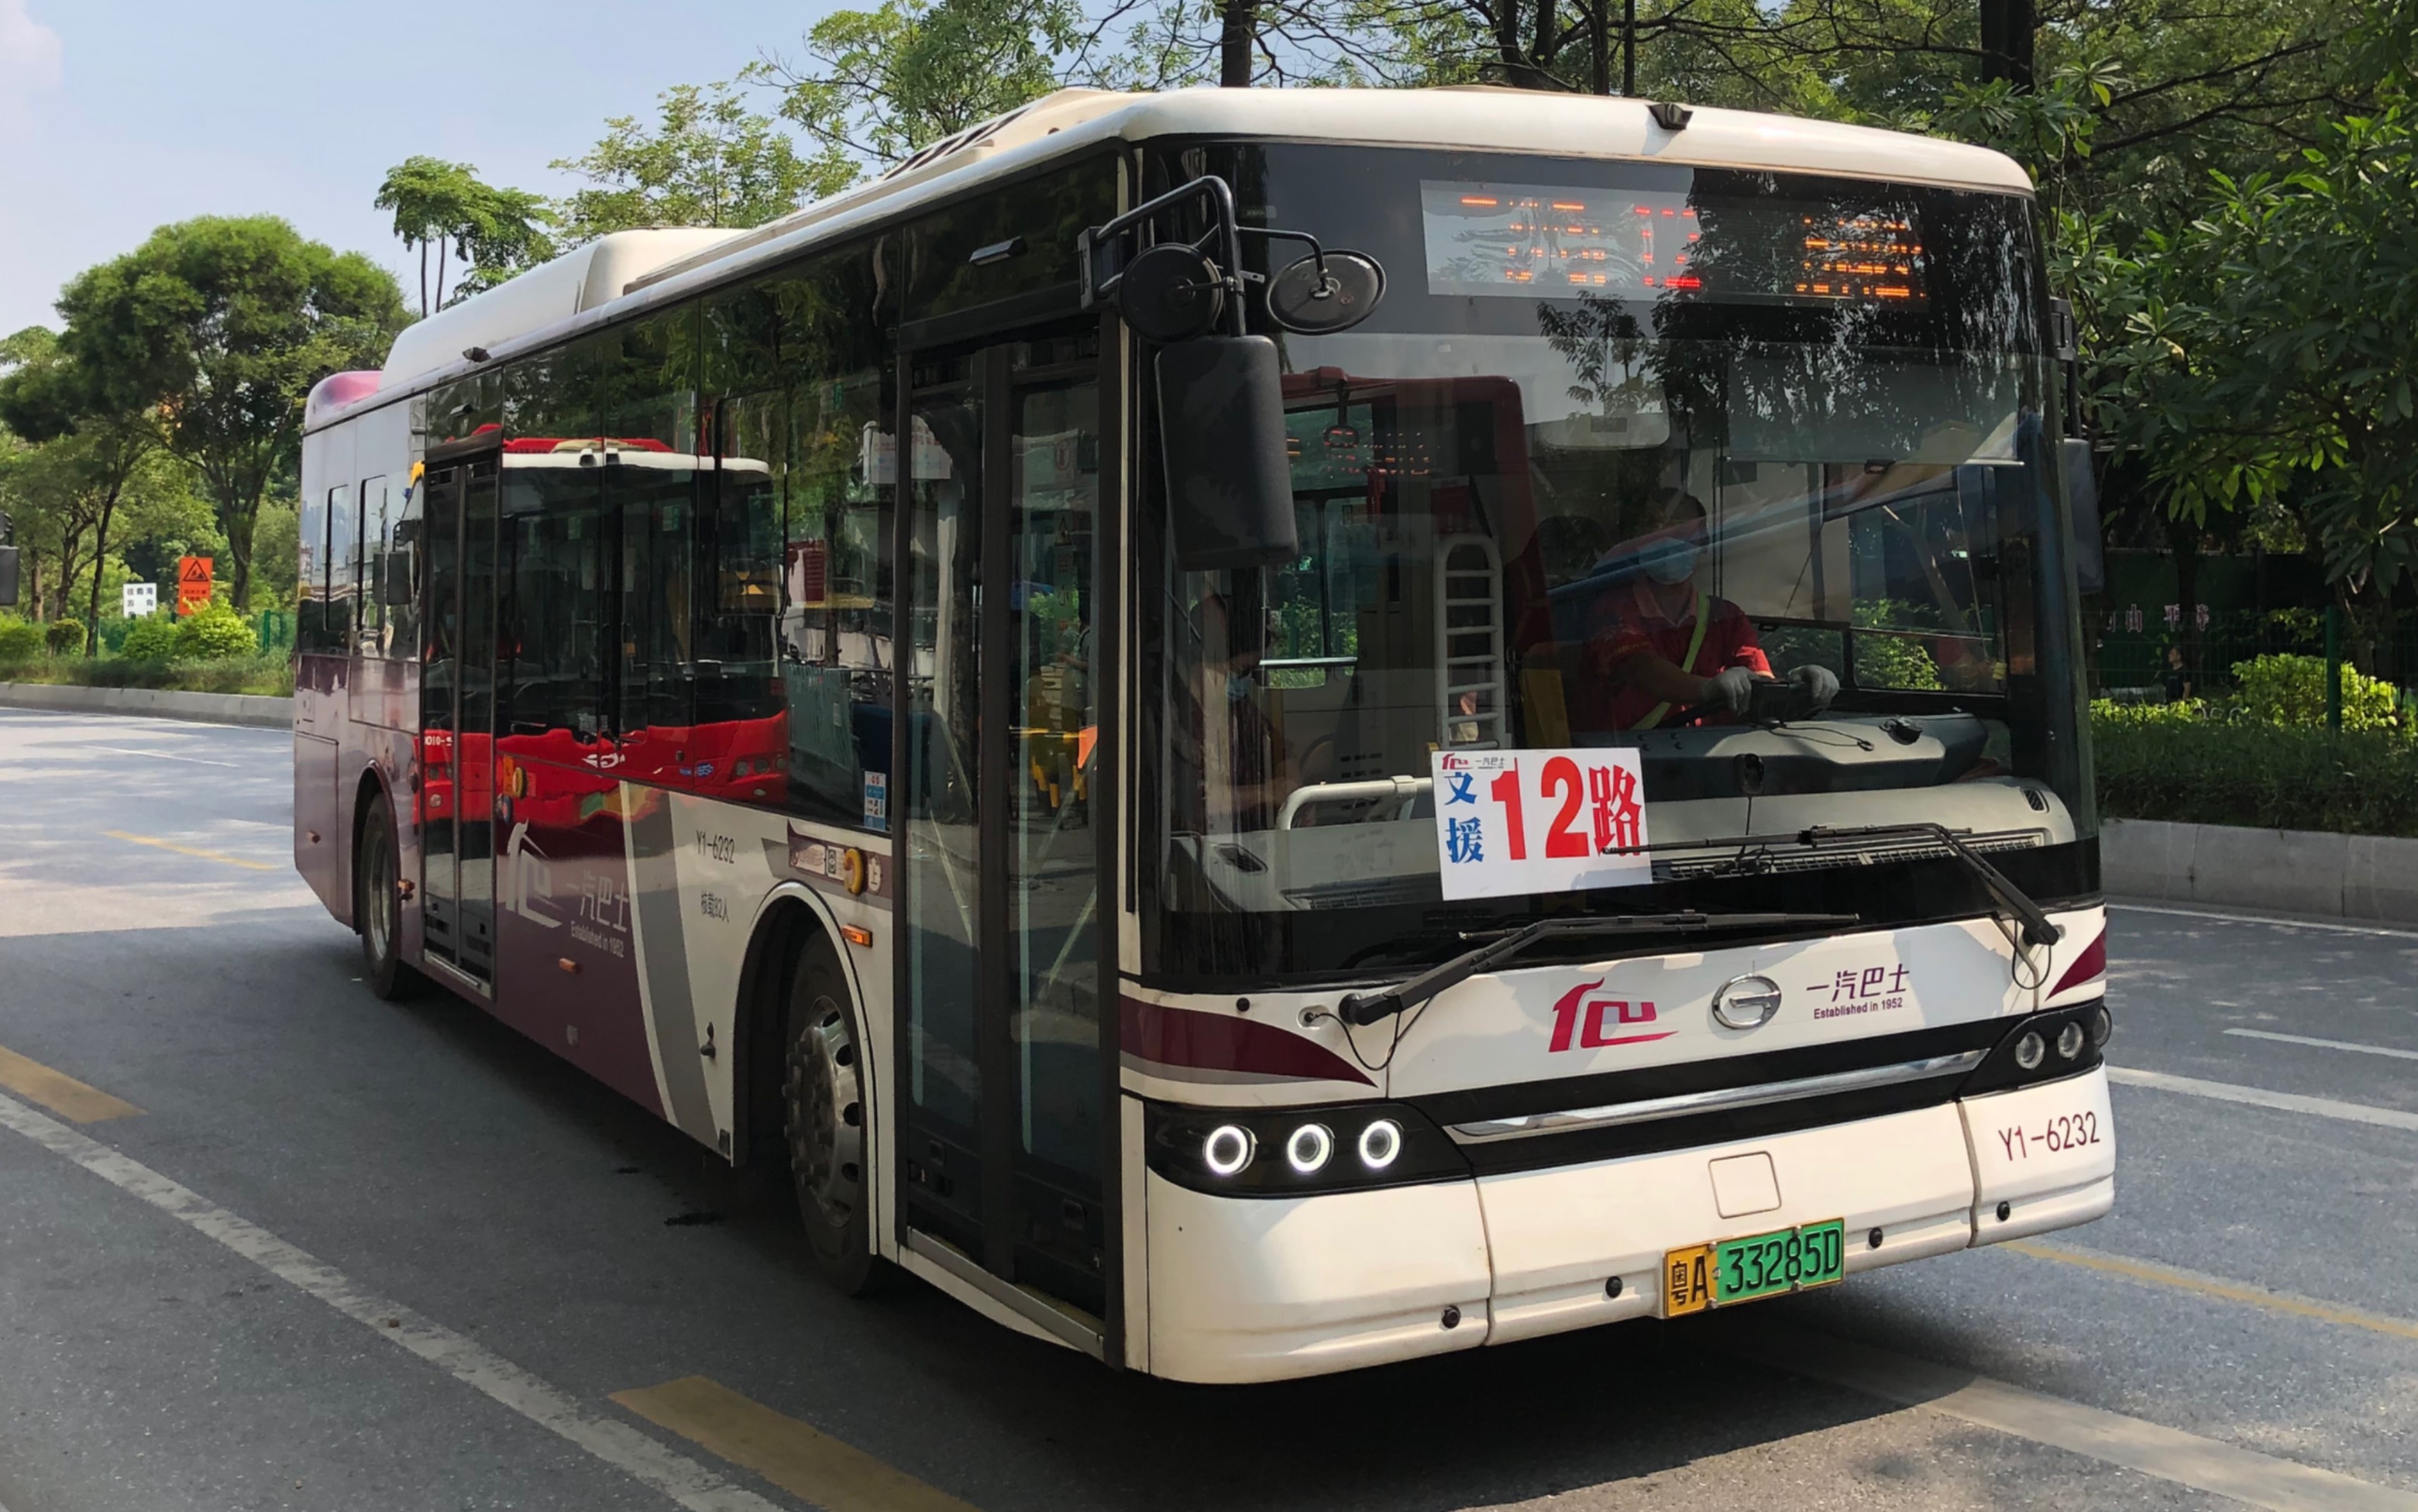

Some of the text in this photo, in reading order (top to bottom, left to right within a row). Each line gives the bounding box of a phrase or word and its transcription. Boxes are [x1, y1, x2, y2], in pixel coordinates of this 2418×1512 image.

[696, 829, 735, 864] Y1-6232
[566, 868, 629, 933] 一汽巴士
[569, 920, 602, 949] Established
[1806, 963, 1910, 1002] 一汽巴士
[1814, 997, 1904, 1019] Established in 1952
[1998, 1112, 2100, 1161] Y1-6232
[1670, 1228, 1841, 1308] 粤A 33285D
